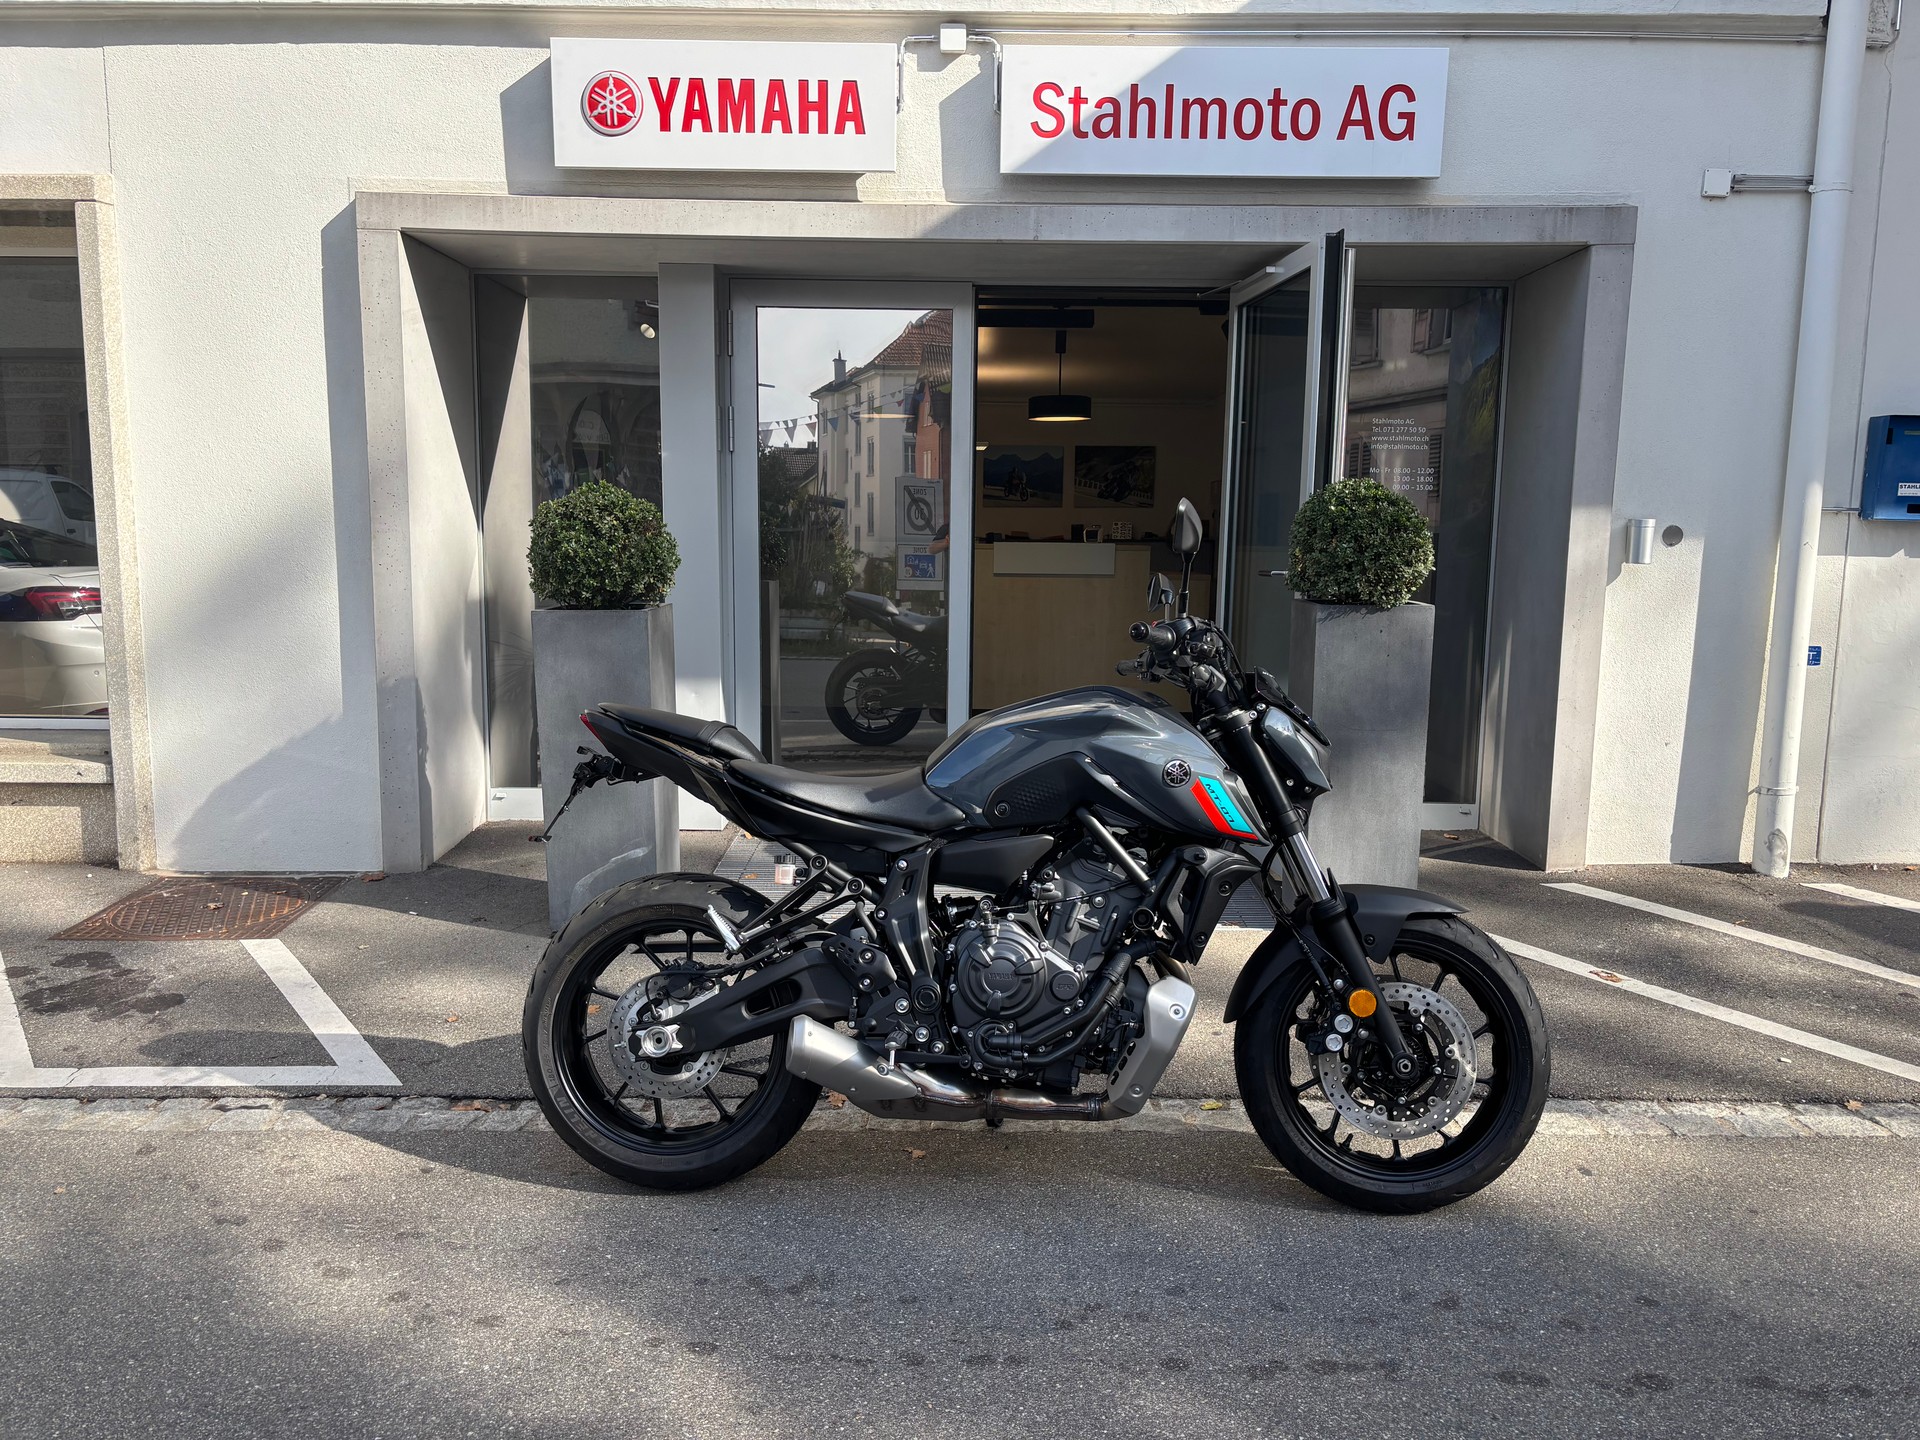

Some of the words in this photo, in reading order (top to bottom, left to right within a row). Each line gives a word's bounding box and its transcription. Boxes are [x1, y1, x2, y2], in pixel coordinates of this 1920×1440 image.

[647, 76, 867, 135] YAMAHA
[1030, 81, 1321, 141] Stahlmoto
[1336, 83, 1417, 142] AG
[1205, 783, 1235, 823] MT-07
